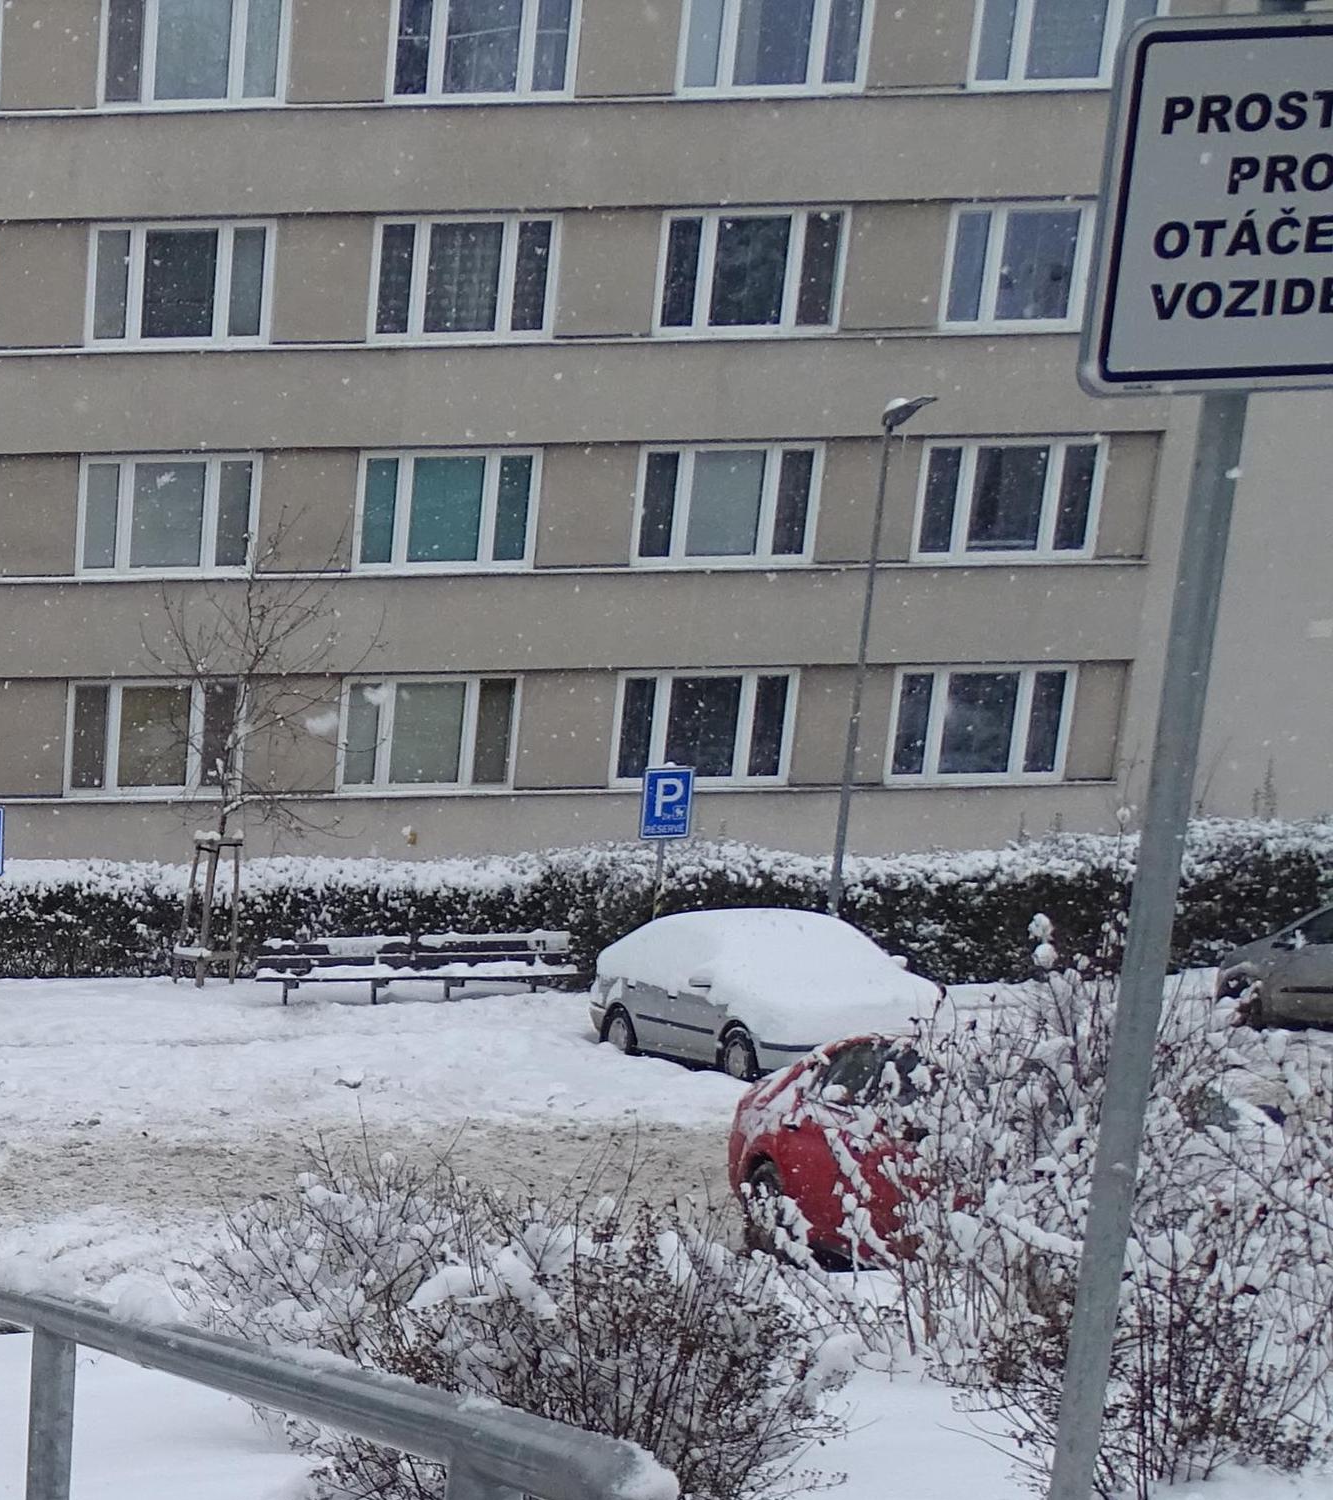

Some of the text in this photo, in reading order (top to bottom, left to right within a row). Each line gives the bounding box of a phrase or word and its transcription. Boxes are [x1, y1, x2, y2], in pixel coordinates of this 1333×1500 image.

[1161, 89, 1333, 135] PROST
[1228, 152, 1333, 194] PRO
[1153, 207, 1333, 260] OTÁČE
[655, 778, 684, 817] P
